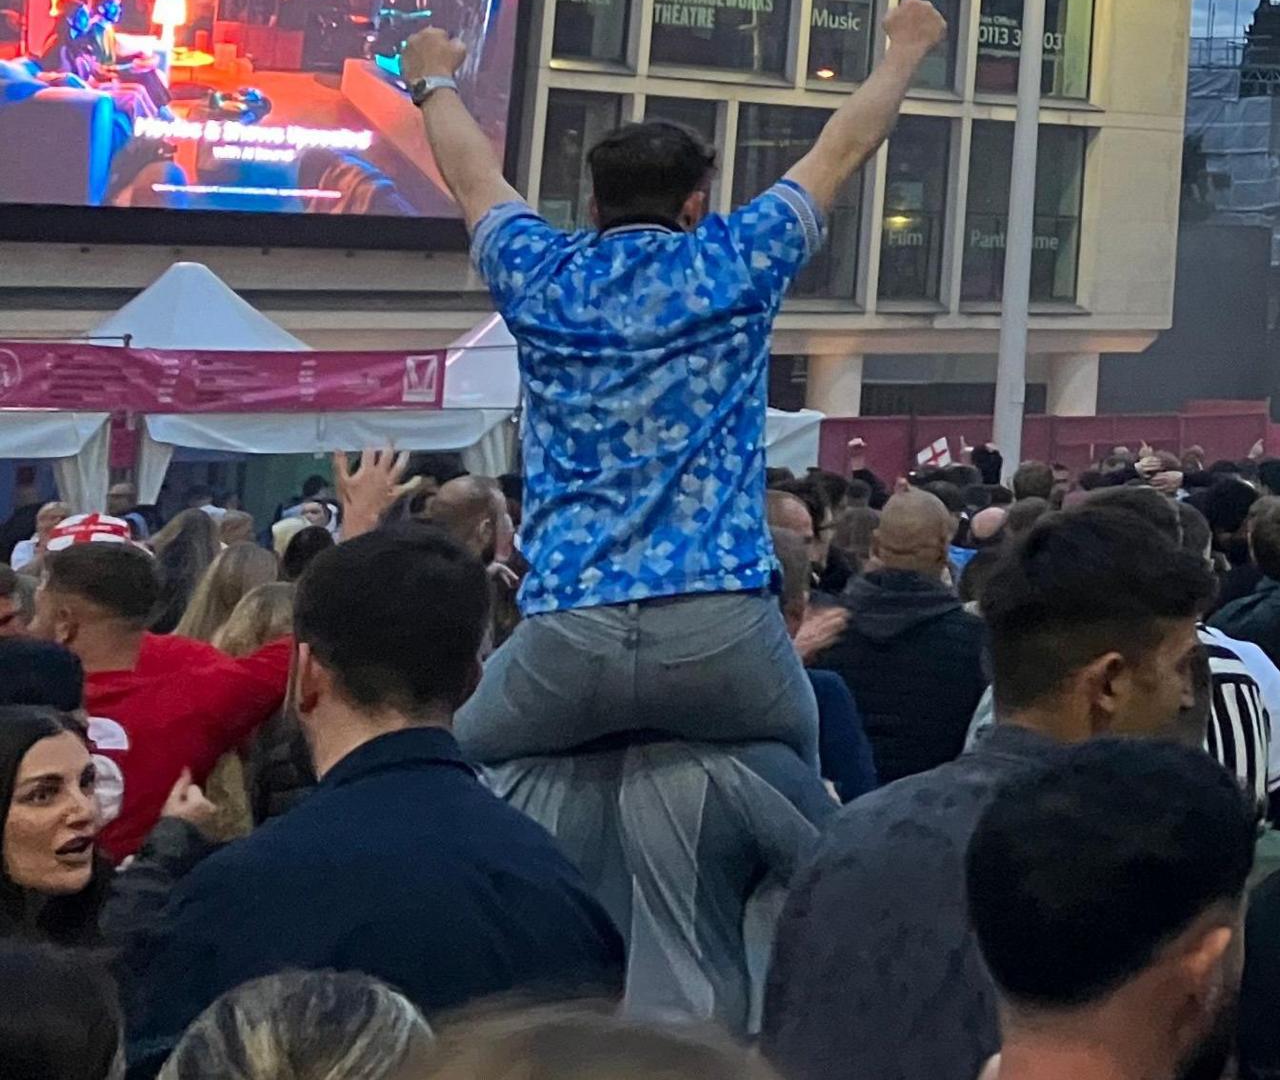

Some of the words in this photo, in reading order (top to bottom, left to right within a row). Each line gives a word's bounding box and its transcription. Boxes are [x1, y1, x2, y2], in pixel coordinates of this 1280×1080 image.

[654, 3, 716, 30] THEATRE
[811, 7, 862, 32] Music
[978, 26, 1009, 45] 0113
[888, 230, 923, 247] Film
[969, 229, 1060, 250] Pantme
